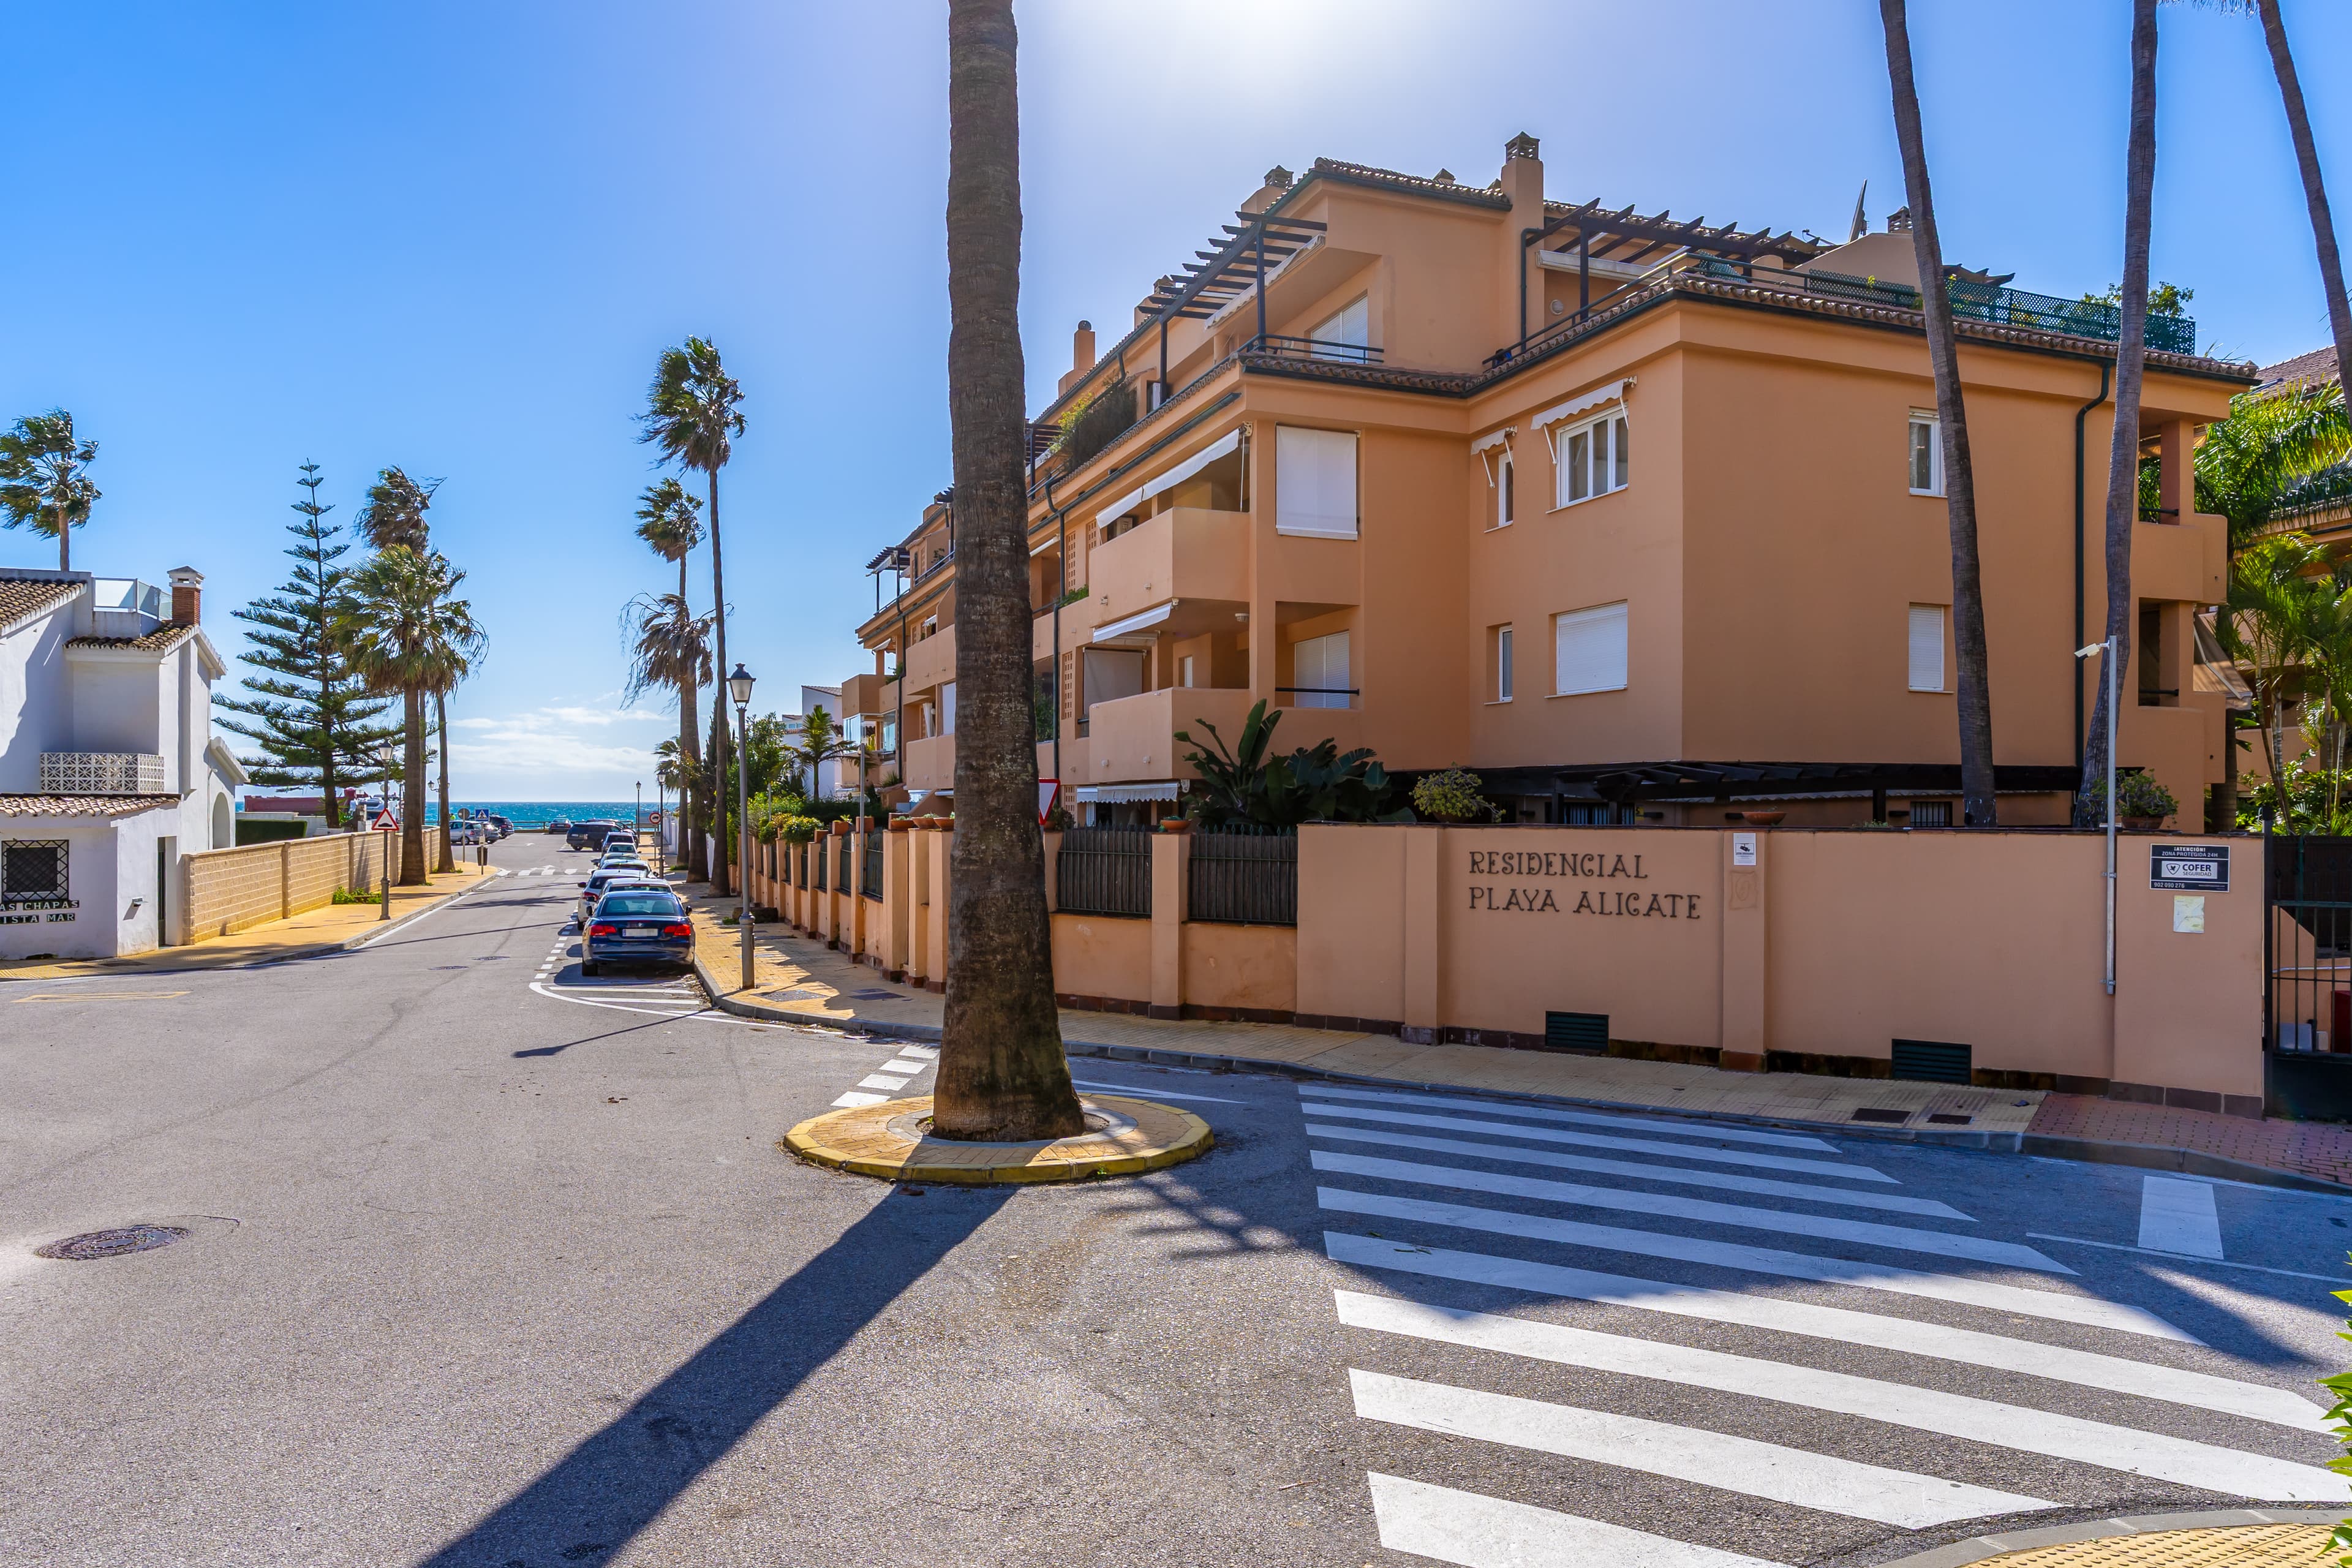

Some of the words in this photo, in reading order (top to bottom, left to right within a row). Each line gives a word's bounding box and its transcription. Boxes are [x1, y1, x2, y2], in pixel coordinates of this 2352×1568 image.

[1469, 851, 1648, 878] RESIDENCIAL
[24, 901, 78, 910] CHAPAS
[1469, 887, 1559, 912] PLAYA
[1573, 891, 1700, 919] ALICATE
[3, 915, 37, 924] ISTA
[47, 913, 74, 922] MAR
